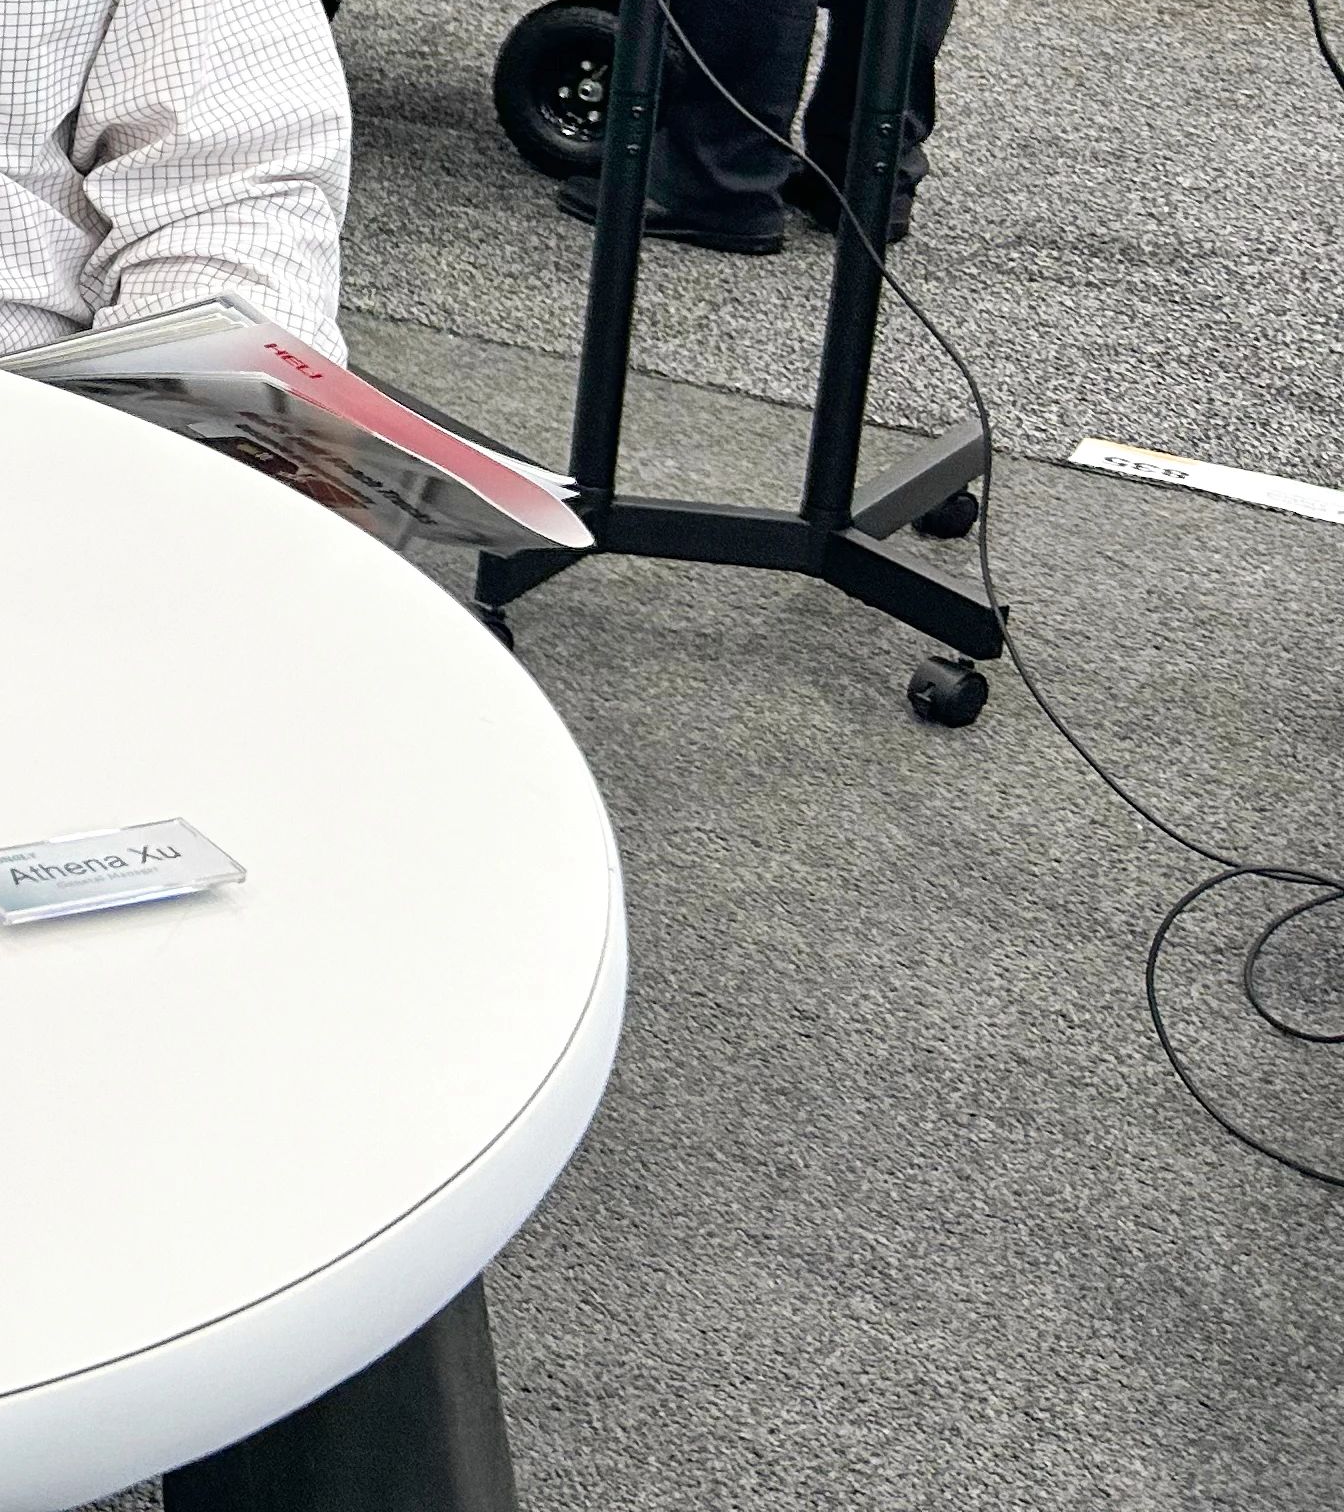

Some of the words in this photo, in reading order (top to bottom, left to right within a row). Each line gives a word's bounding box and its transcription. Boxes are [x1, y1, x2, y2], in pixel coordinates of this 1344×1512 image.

[264, 342, 323, 380] HELI
[9, 854, 129, 885] Athena
[127, 844, 182, 864] Xu
